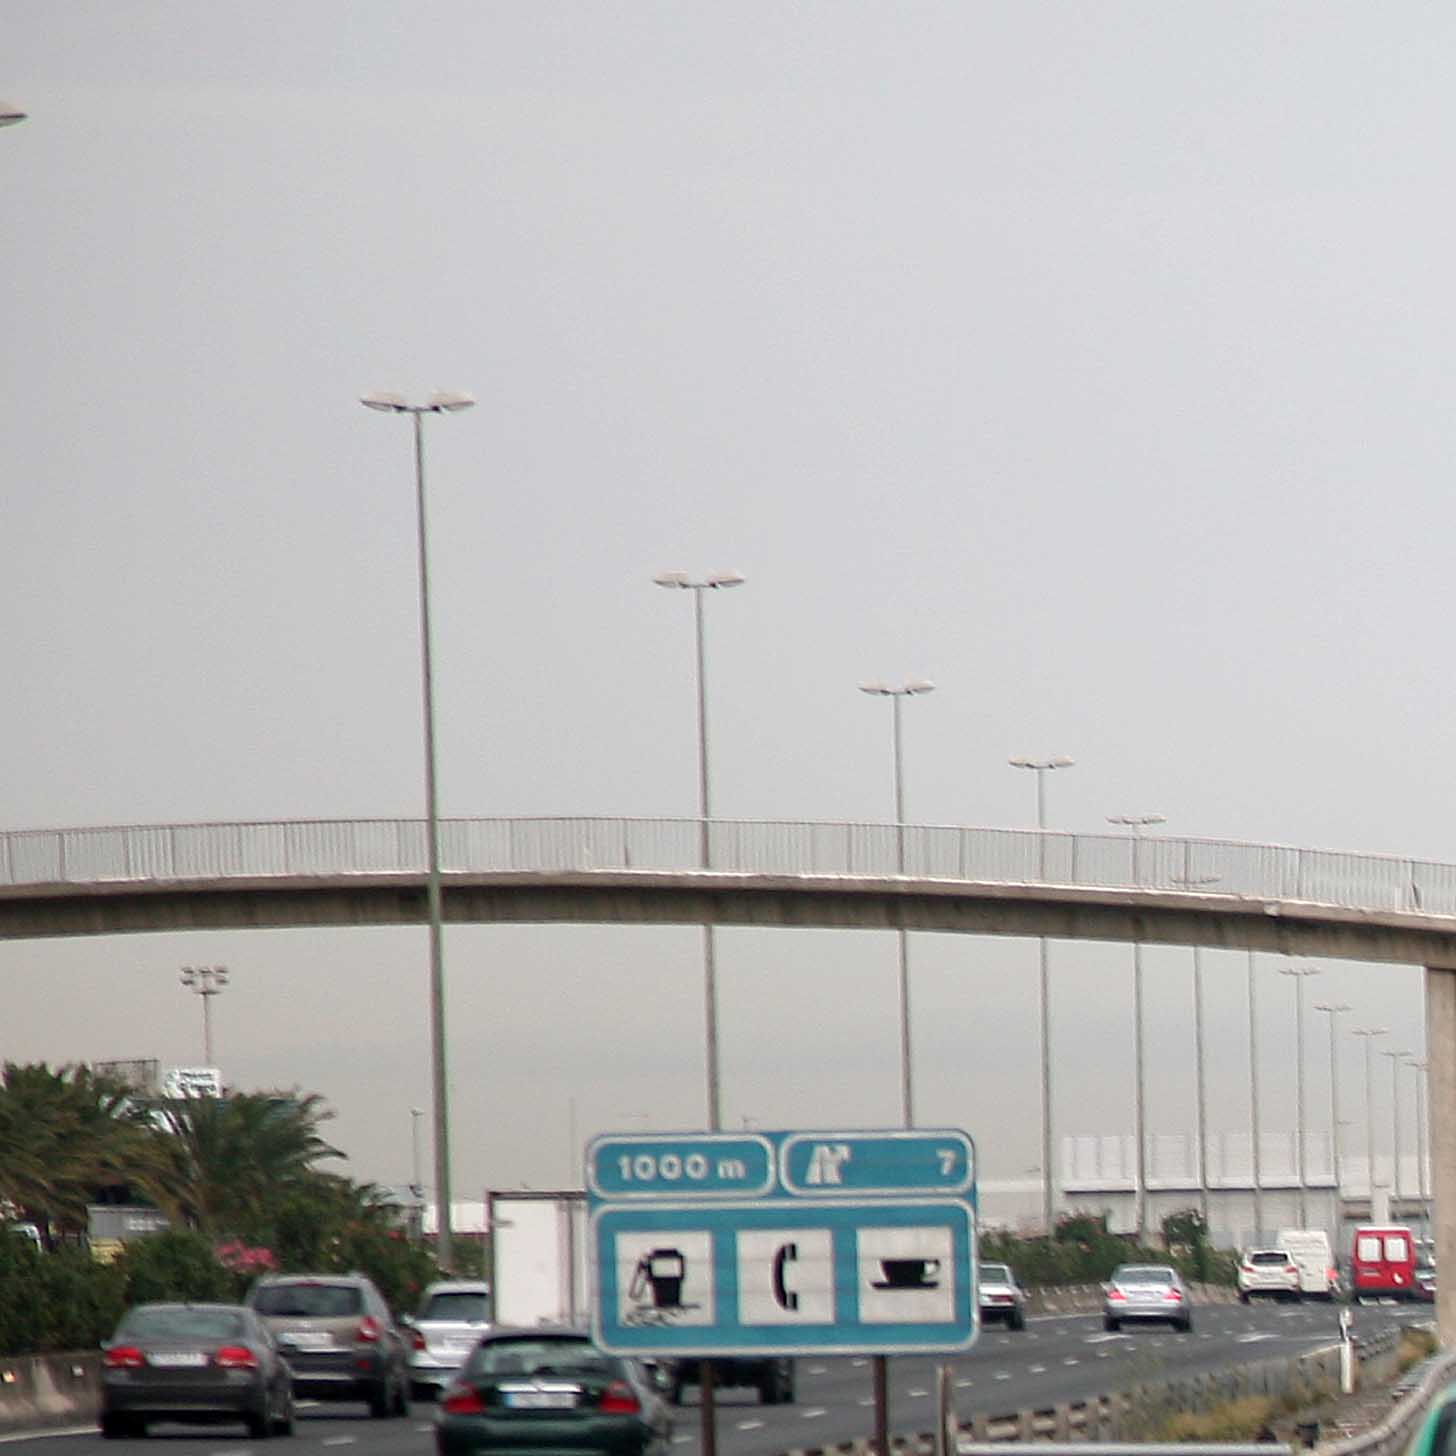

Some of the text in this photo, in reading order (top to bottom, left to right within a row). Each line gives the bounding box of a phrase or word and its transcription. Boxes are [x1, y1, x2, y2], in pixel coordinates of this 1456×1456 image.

[617, 1154, 747, 1182] 1000 m
[935, 1149, 957, 1176] 7
